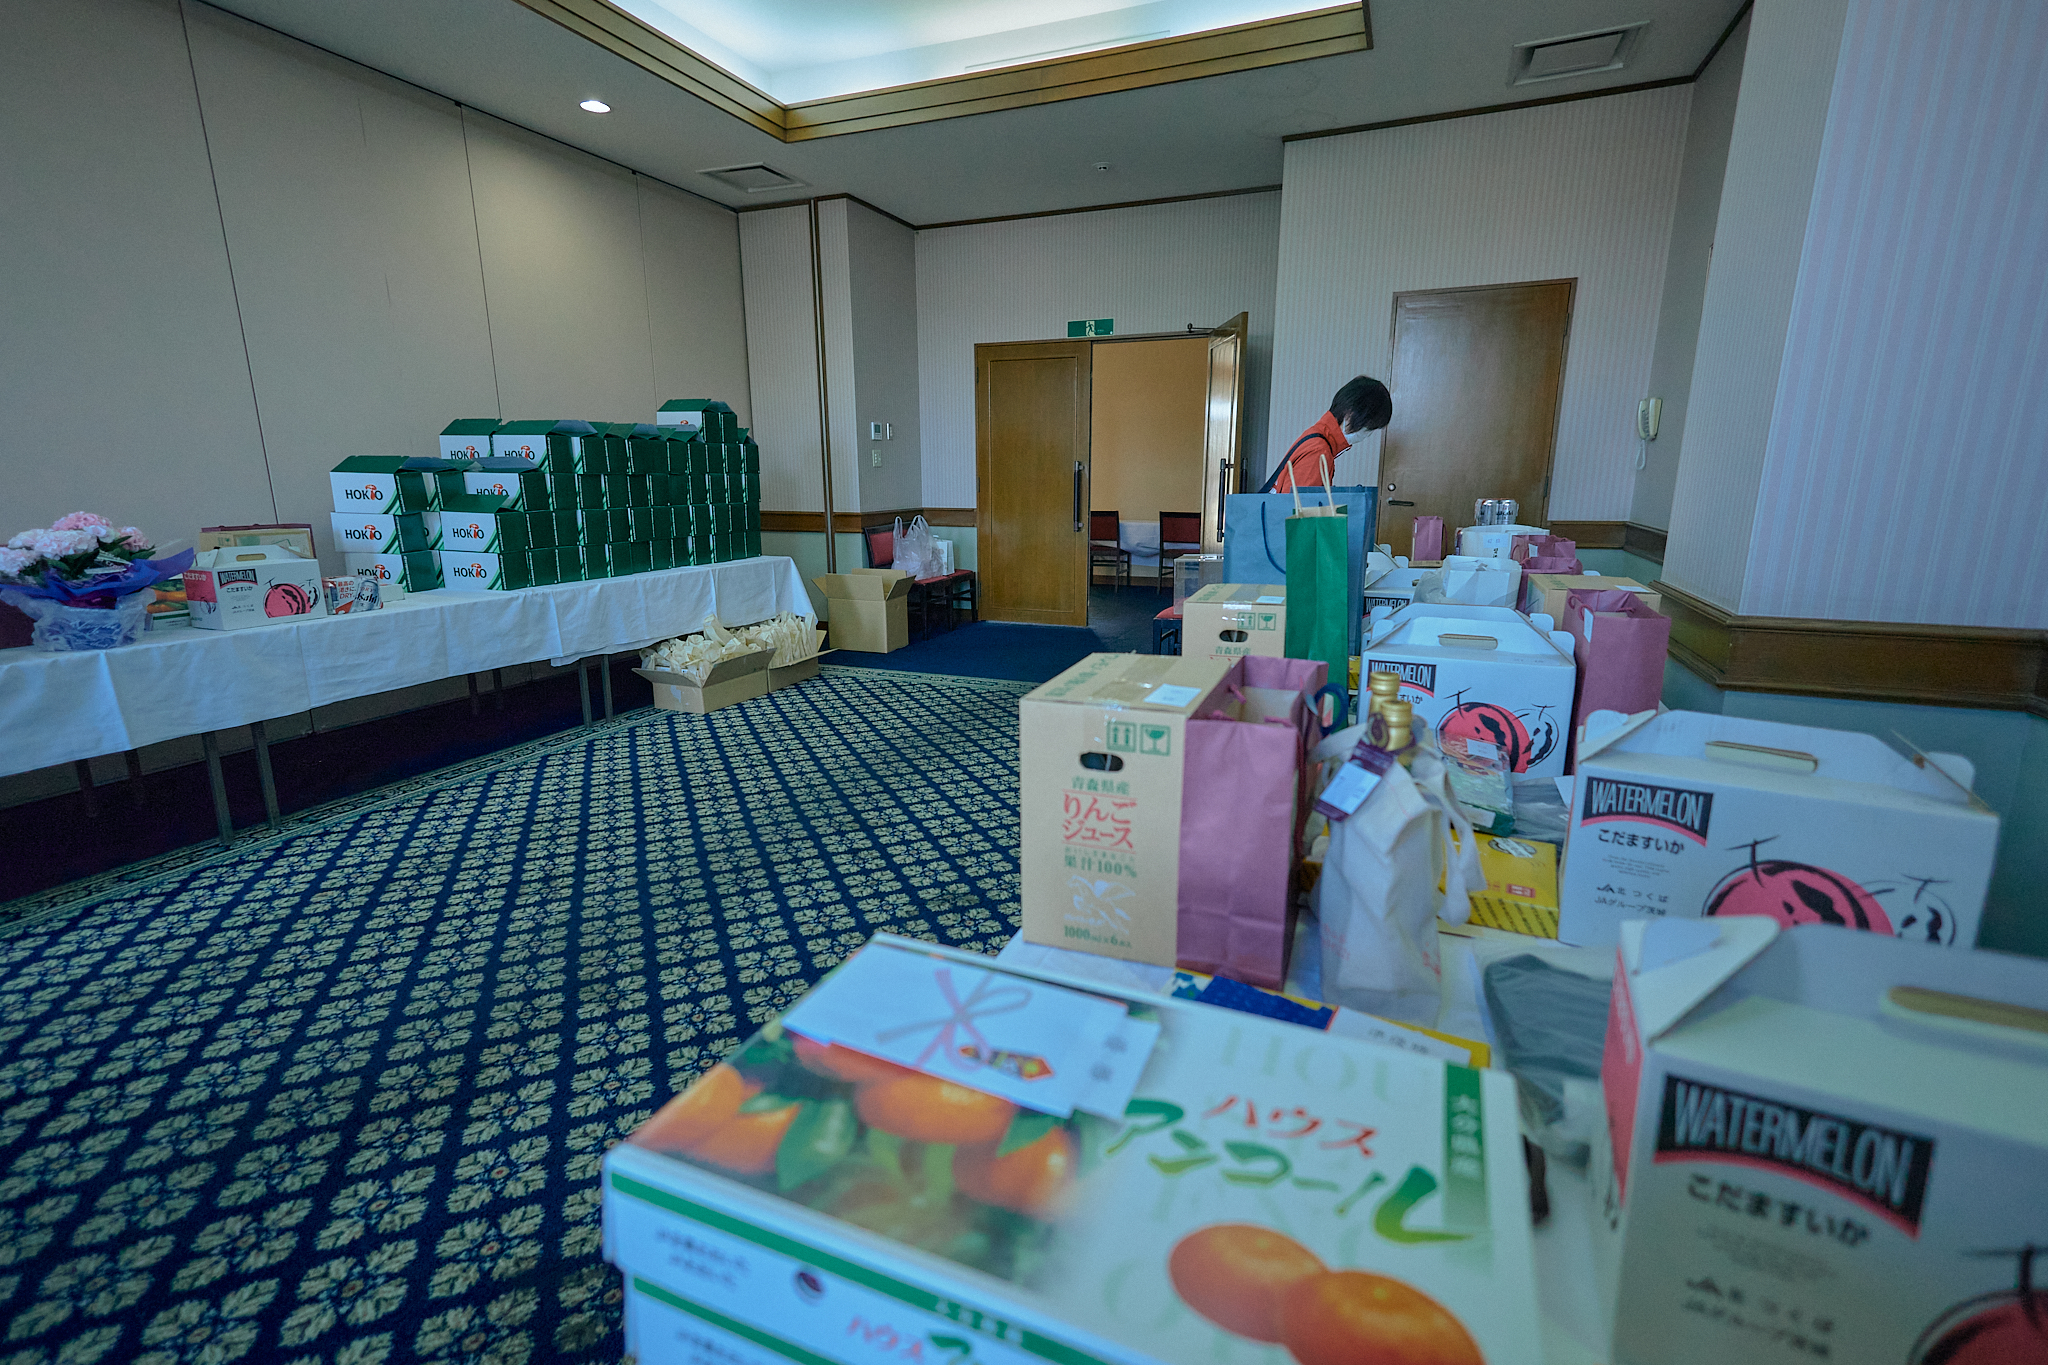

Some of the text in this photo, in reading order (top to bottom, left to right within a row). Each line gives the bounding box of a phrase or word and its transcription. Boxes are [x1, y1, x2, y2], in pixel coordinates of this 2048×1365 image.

[219, 570, 255, 585] WATERMELON
[1063, 793, 1138, 825] りんご
[1591, 779, 1705, 831] WATERMELON
[1062, 820, 1134, 850] ジュース
[1598, 828, 1685, 855] こだますいか
[1202, 1094, 1379, 1159] ハウス
[1674, 1080, 1916, 1207] WATERMELON
[1103, 1096, 1477, 1246] アンコール
[1687, 1172, 1872, 1248] こだますいか
